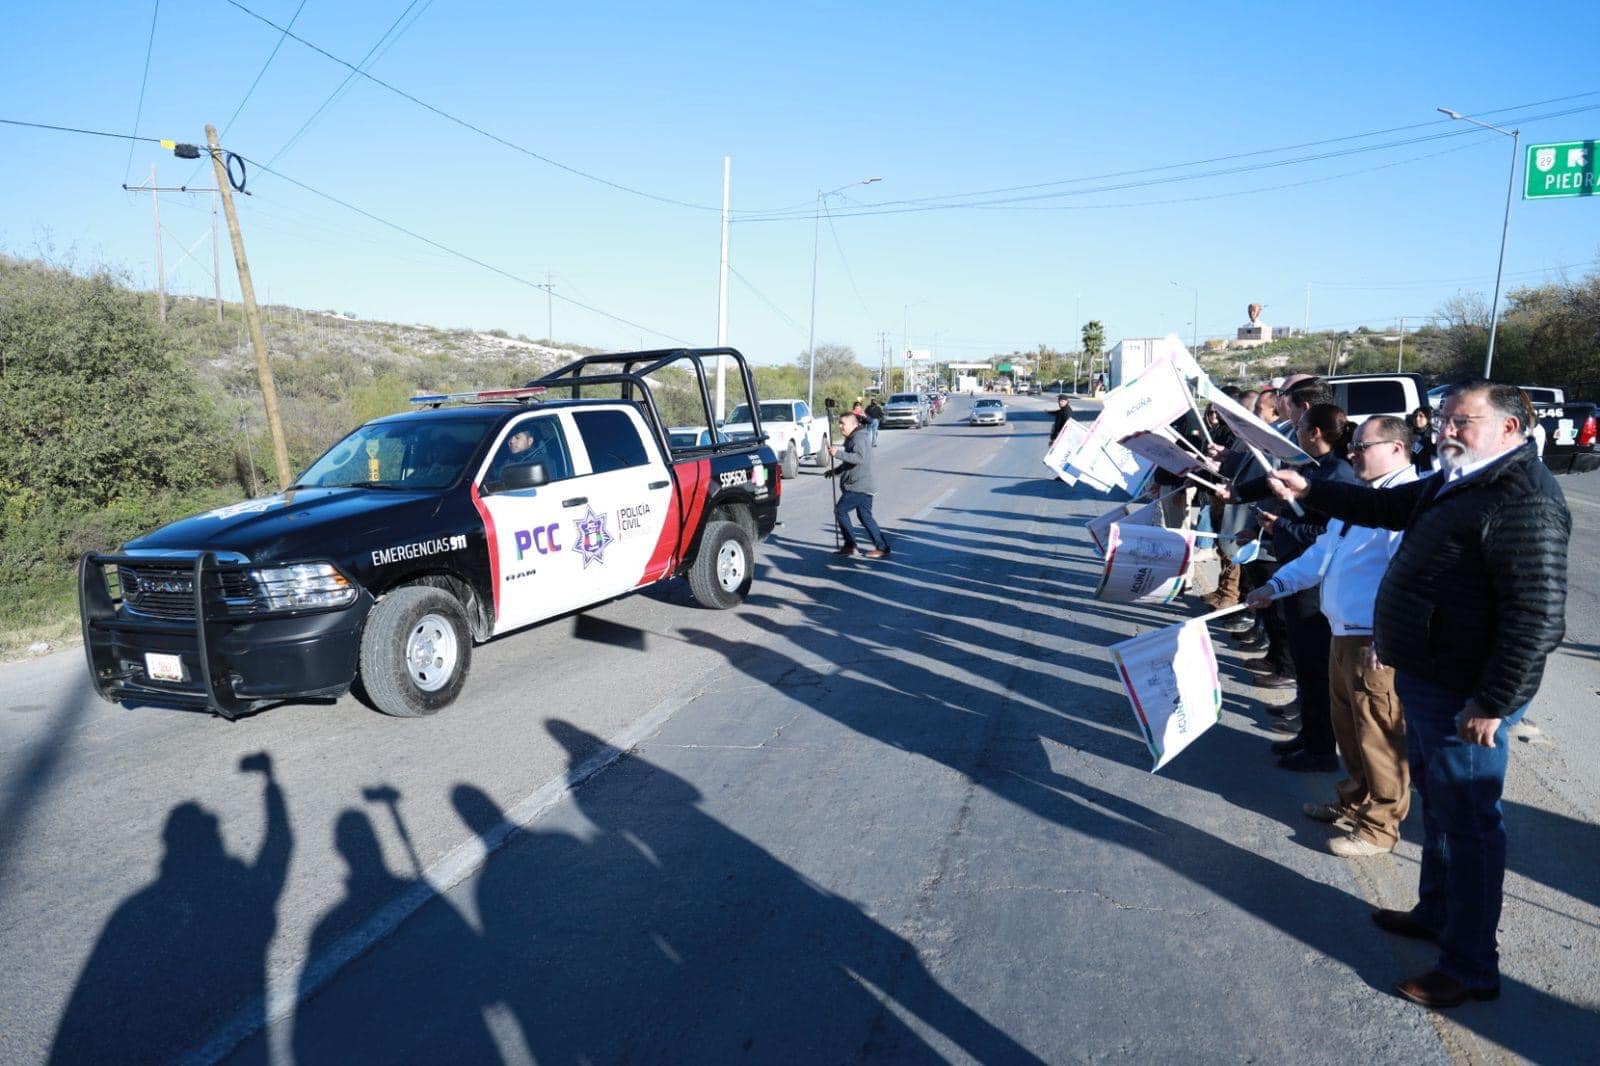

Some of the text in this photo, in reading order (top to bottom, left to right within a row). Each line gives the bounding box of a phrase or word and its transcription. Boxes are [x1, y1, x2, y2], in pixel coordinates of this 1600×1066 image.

[1540, 157, 1552, 166] 29
[1534, 408, 1564, 418] 546
[622, 518, 641, 530] CIVIL
[371, 534, 468, 567] EMERGENCIAS 911
[514, 522, 562, 561] PCC
[1130, 566, 1148, 594] ACUÑA
